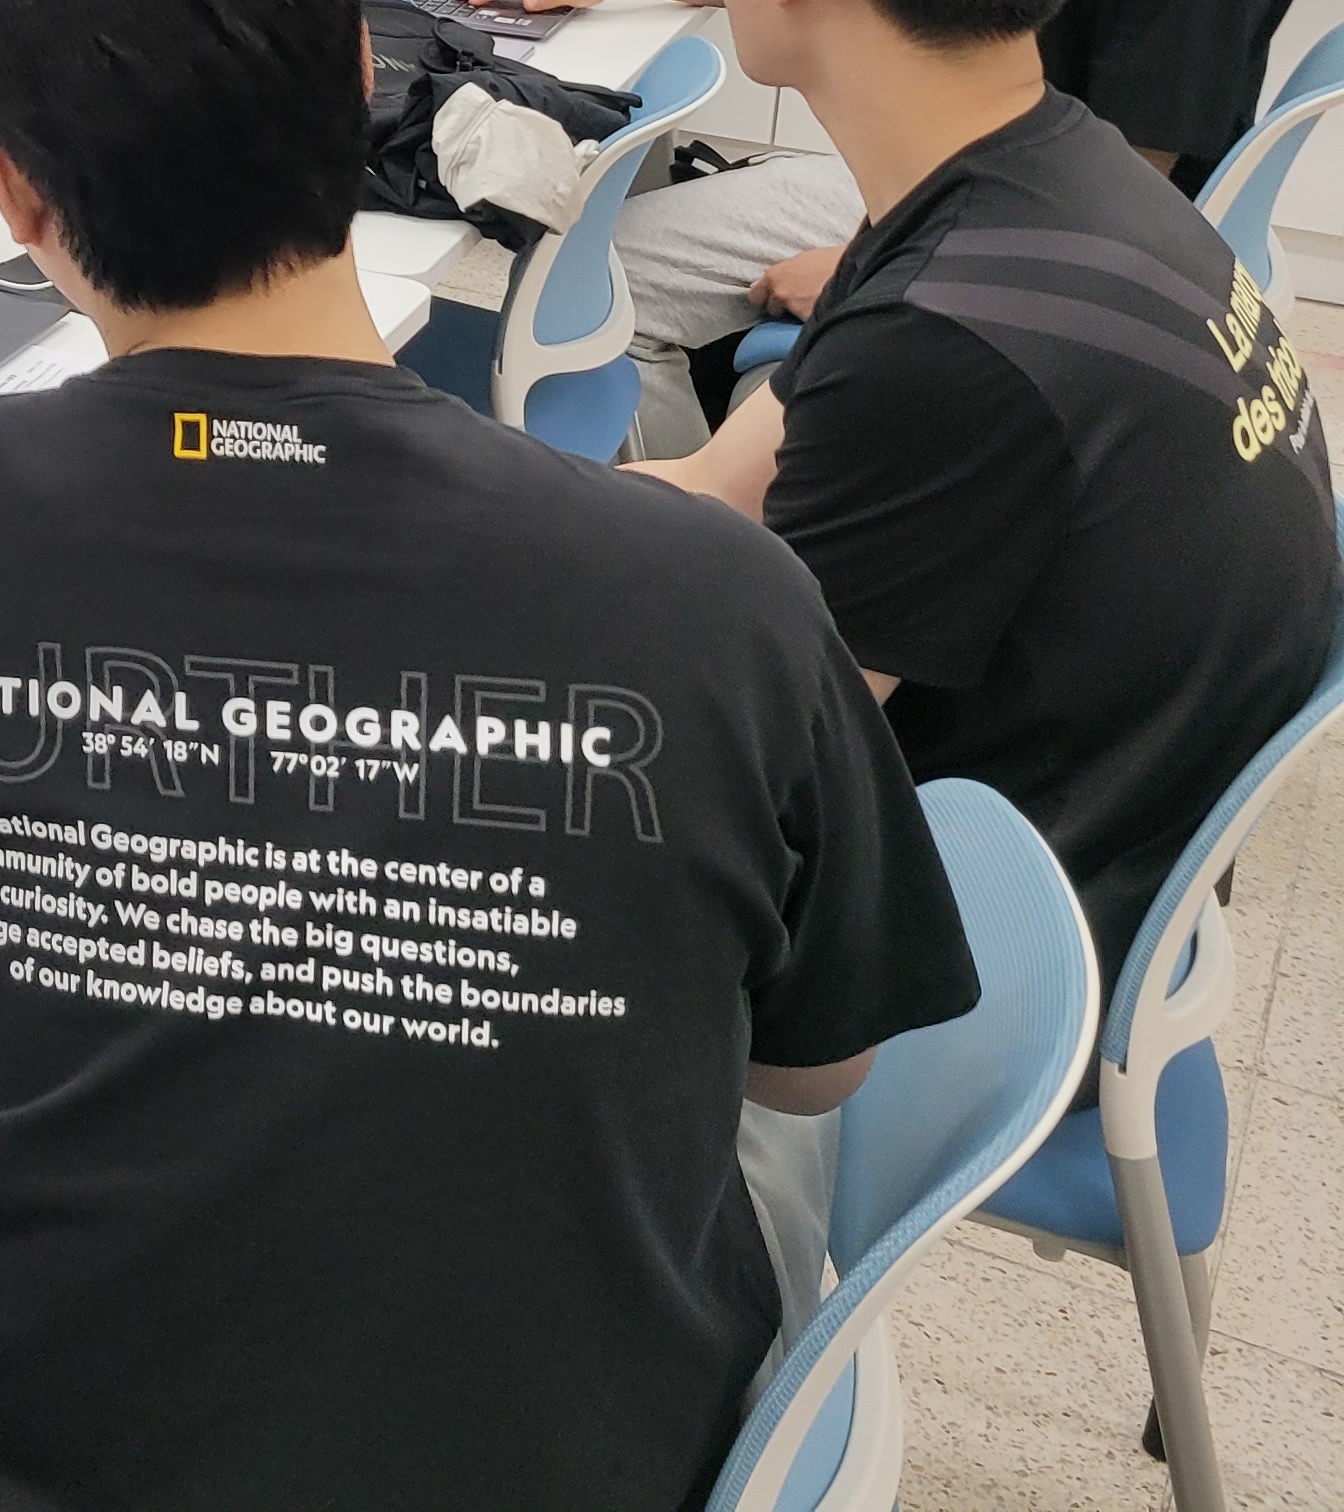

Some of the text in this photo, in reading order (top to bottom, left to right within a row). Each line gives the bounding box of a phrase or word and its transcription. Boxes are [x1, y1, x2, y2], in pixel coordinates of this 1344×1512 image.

[210, 438, 328, 465] GEOGRAPHIC
[212, 419, 302, 444] NATIONAL
[1232, 385, 1287, 463] des
[222, 696, 614, 770] GEOGRAPHIC
[90, 823, 259, 867] Geographic
[264, 842, 287, 870] is
[292, 847, 321, 874] at
[326, 847, 379, 881] the
[384, 857, 484, 892] center
[489, 866, 523, 897] of
[528, 874, 546, 899] a
[0, 884, 520, 978] curiosity. We chase the big questions,
[95, 862, 126, 888] of
[131, 863, 198, 899] bold
[204, 878, 302, 911] people
[309, 887, 378, 918] with
[383, 895, 421, 924] an
[427, 896, 577, 941] insatiable
[9, 956, 500, 1050] of our knowledge about our world.
[26, 925, 146, 967] accepted
[152, 940, 254, 985] beliefs,
[260, 957, 315, 984] and
[322, 963, 394, 997] push
[401, 973, 453, 1005] the
[460, 978, 627, 1018] boundaries
